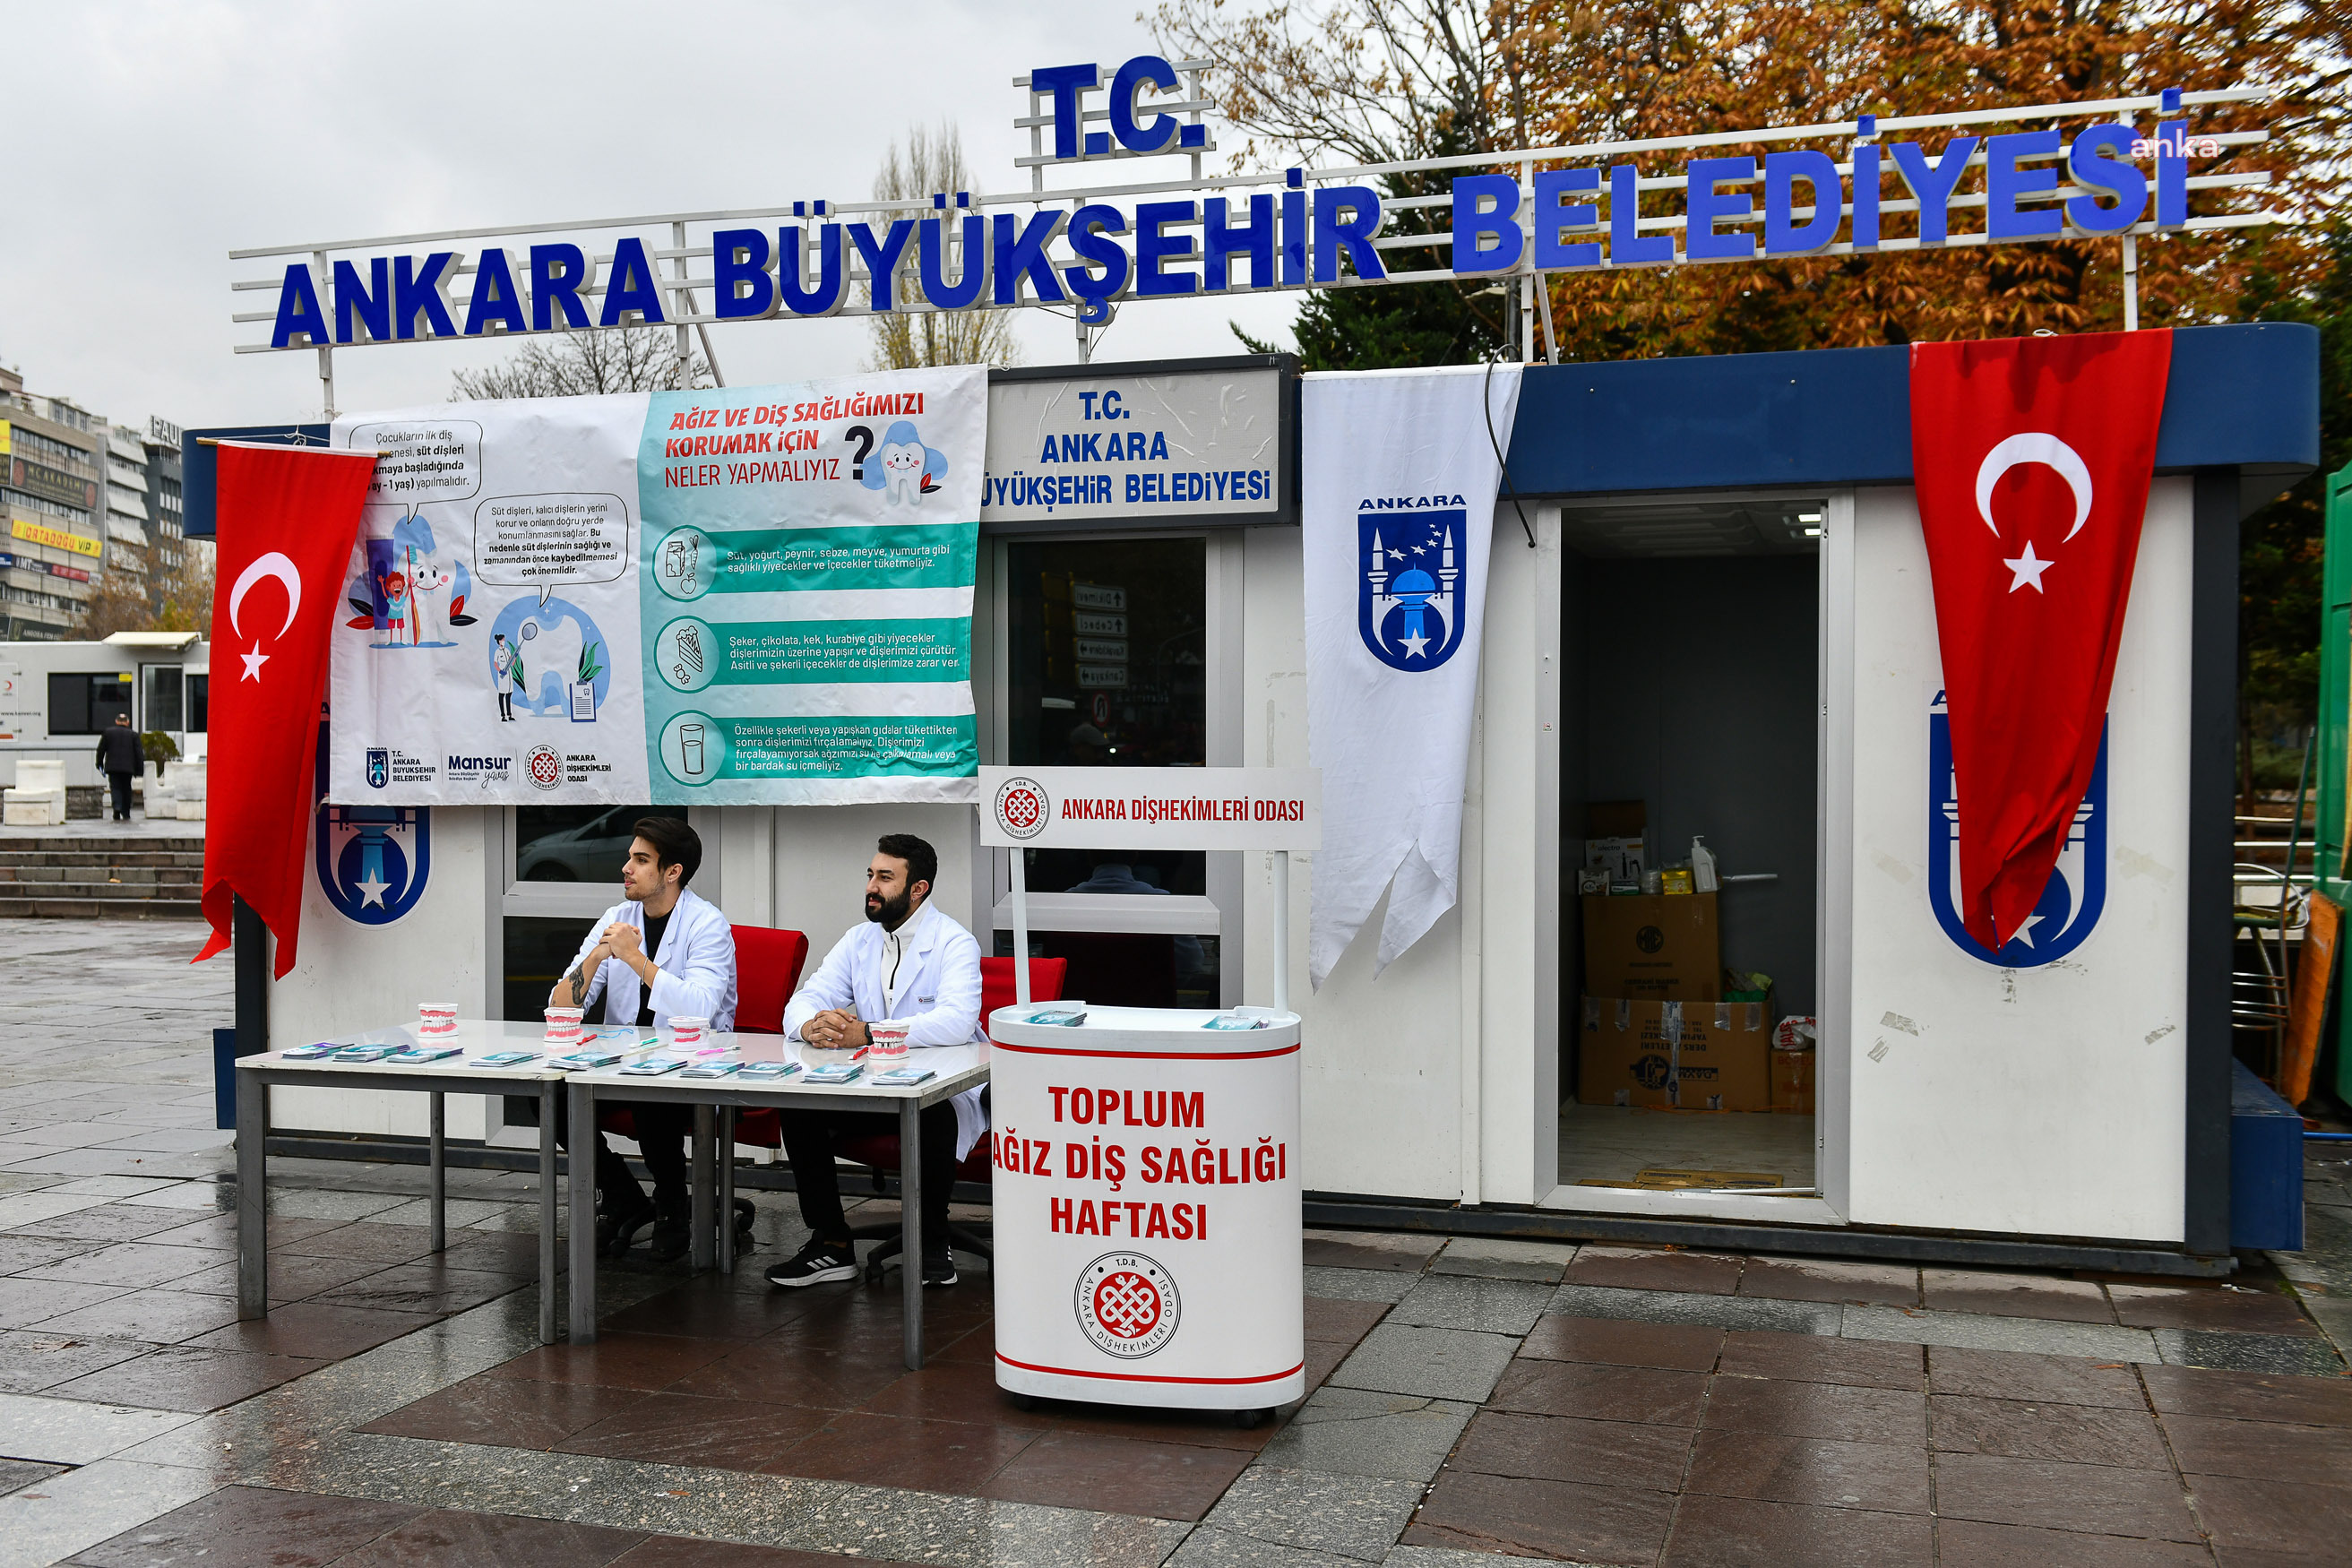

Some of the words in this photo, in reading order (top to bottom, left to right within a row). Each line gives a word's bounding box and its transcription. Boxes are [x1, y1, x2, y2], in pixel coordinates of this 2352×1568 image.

[1031, 55, 1206, 159] T.C.
[271, 237, 668, 349] ANKARA
[712, 167, 1389, 325] BÜYÜKŞEHİR
[1452, 88, 2188, 274] BELEDİYESİ
[669, 405, 719, 431] AĞIZ
[724, 408, 748, 428] VE
[791, 391, 924, 423] SAĞLIĞIMIZI
[1079, 389, 1130, 421] T.C.
[376, 431, 424, 445] Çocukların
[426, 430, 436, 441] ilk
[439, 430, 452, 442] diş
[665, 432, 773, 459] KORUMAK
[417, 446, 431, 456] süt
[434, 444, 464, 458] dişleri
[1040, 431, 1169, 463] ANKARA
[404, 461, 464, 475] başladığında
[665, 463, 720, 488] NELER
[727, 458, 840, 486] YAPMALIYIZ
[394, 478, 415, 492] yaş)
[416, 476, 470, 491] yapılmalıdır.
[980, 470, 1112, 513] ÜYÜKŞEHİR
[491, 506, 504, 516] Süt
[506, 505, 534, 517] dişleri,
[536, 505, 554, 515] kalıcı
[555, 504, 585, 515] dişlerin
[586, 503, 607, 514] yerini
[1358, 494, 1467, 510] ANKARA
[495, 519, 517, 528] korur
[530, 518, 556, 527] onların
[556, 517, 580, 527] doğru
[582, 516, 604, 527] yerde
[25, 526, 75, 549] ORTADOĞU
[498, 530, 561, 540] konumlanmasını
[562, 529, 589, 539] sağlar.
[590, 529, 601, 537] Bu
[488, 543, 520, 553] nedenle
[521, 542, 535, 552] süt
[536, 541, 572, 552] dişlerinin
[573, 540, 600, 551] sağlığı
[601, 541, 612, 549] ve
[727, 551, 747, 561] Süt,
[749, 550, 783, 562] yoğurt,
[785, 547, 817, 561] peynir,
[820, 547, 850, 558] sebze,
[852, 547, 887, 559] meyve,
[890, 546, 930, 558] yumurta
[932, 544, 950, 557] gibi
[484, 556, 530, 564] zamanından
[532, 554, 549, 564] önce
[551, 552, 617, 564] kaybedilmemesi
[728, 562, 761, 574] sağlıklı
[762, 561, 811, 573] yiyecekler
[827, 559, 872, 572] içecekler
[874, 557, 935, 570] tüketmeliyiz.
[521, 566, 537, 577] çok
[538, 565, 577, 575] önemlidir.
[729, 636, 759, 649] Şeker,
[762, 635, 801, 647] çikolata,
[803, 634, 823, 645] kek,
[825, 633, 866, 645] kurabiye
[868, 633, 885, 645] gibi
[887, 633, 935, 645] yiyecekler
[730, 647, 785, 659] dişlerimizin
[788, 647, 822, 658] üzerine
[823, 646, 854, 659] yapışır
[856, 648, 866, 656] ve
[869, 645, 918, 658] dişlerimizi
[730, 659, 754, 670] Asitli
[757, 661, 768, 669] ve
[771, 659, 801, 671] şekerli
[803, 659, 847, 671] içecekler
[849, 659, 860, 668] de
[863, 658, 913, 670] dişlerimize
[916, 659, 939, 668] zarar
[734, 723, 774, 735] Özellikle
[776, 724, 806, 737] şekerli
[808, 727, 830, 737] veya
[831, 725, 870, 737] yapışkan
[873, 725, 902, 737] gıdalar
[904, 724, 957, 735] tükettikten
[736, 738, 762, 746] sonra
[764, 737, 812, 748] dişlerimizi
[814, 737, 875, 748] fırçalamalıyız.
[877, 737, 925, 749] Dişlerimizi
[448, 755, 512, 770] Mansur
[566, 754, 596, 762] ANKARA
[736, 748, 820, 760] fırçalayamıyorsak
[821, 748, 858, 761] ağzımızı
[935, 751, 956, 761] veya
[736, 761, 749, 771] bir
[751, 761, 784, 771] bardak
[786, 762, 797, 771] su
[799, 761, 843, 772] içmeliyiz.
[1062, 798, 1127, 821] ANKARA
[1132, 795, 1249, 824] DİŞHEKİMLERİ
[1254, 799, 1304, 822] ODASI
[1047, 1086, 1205, 1129] TOPLUM
[992, 1126, 1051, 1177] AĞIZ
[1065, 1134, 1126, 1192] DİŞ
[1140, 1136, 1287, 1186] SAĞLIĞI
[1050, 1196, 1207, 1241] HAFTASI
[1116, 1258, 1138, 1268] T.D.B.
[1082, 1276, 1095, 1329] ANKARA
[1158, 1279, 1173, 1318] ODASI
